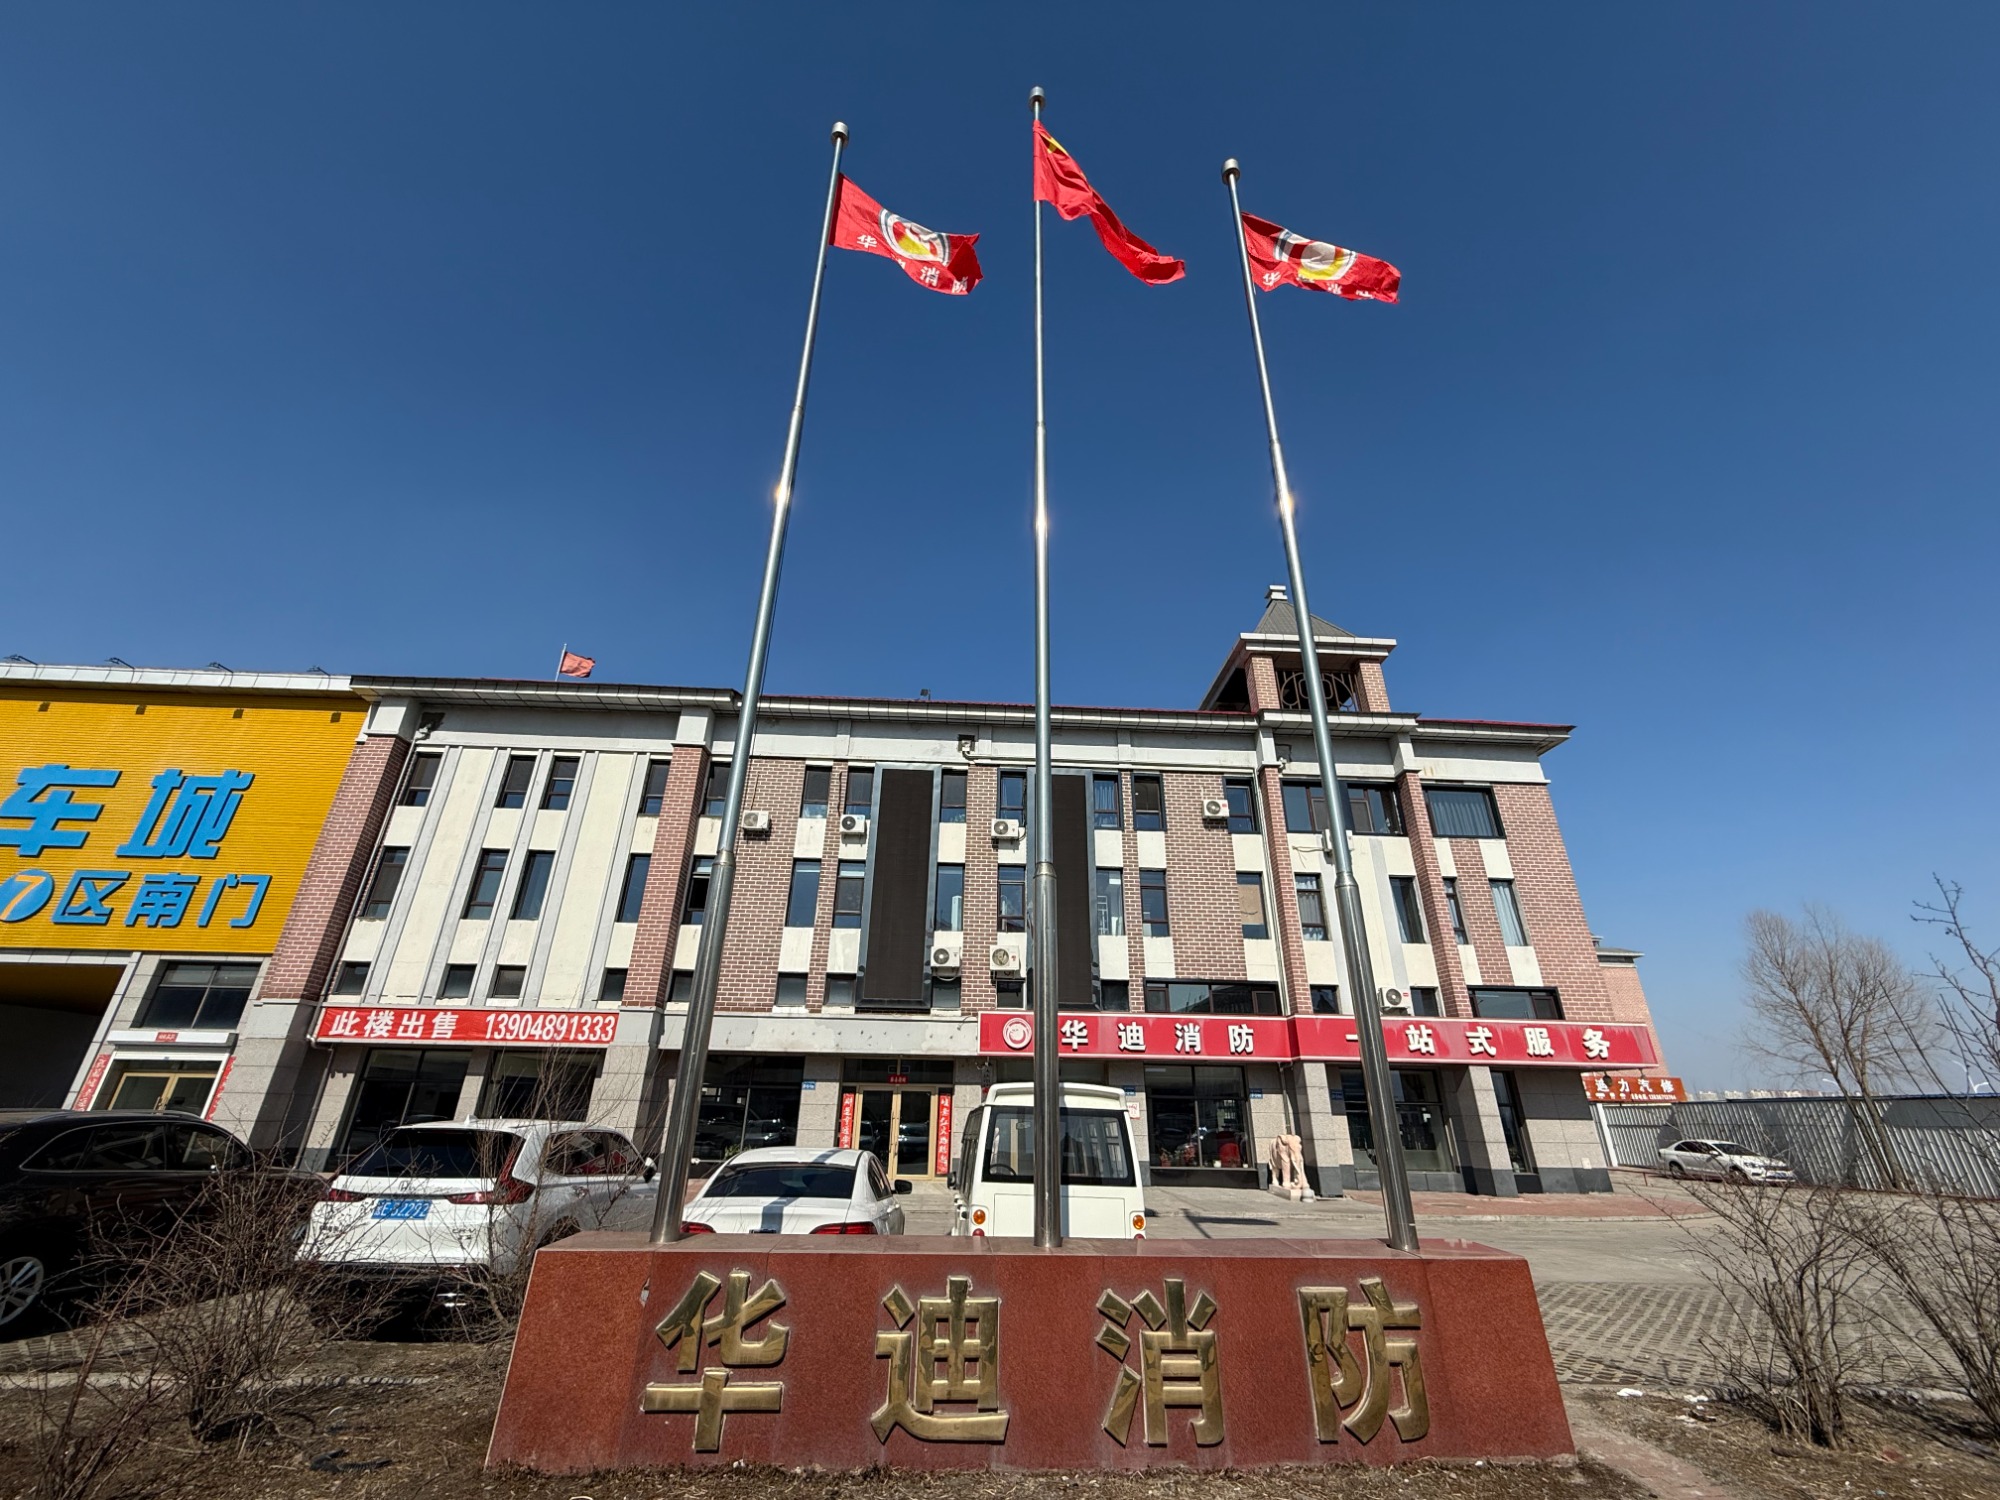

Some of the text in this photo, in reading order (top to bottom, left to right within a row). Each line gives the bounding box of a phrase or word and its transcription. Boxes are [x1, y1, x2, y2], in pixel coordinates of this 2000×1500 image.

[0, 764, 255, 859] 车城
[0, 869, 273, 928] 7区南门
[328, 1010, 615, 1042] 此楼出售 13904891333
[1060, 1019, 1254, 1054] 华迪消防
[639, 1270, 1430, 1454] 华迪消防
